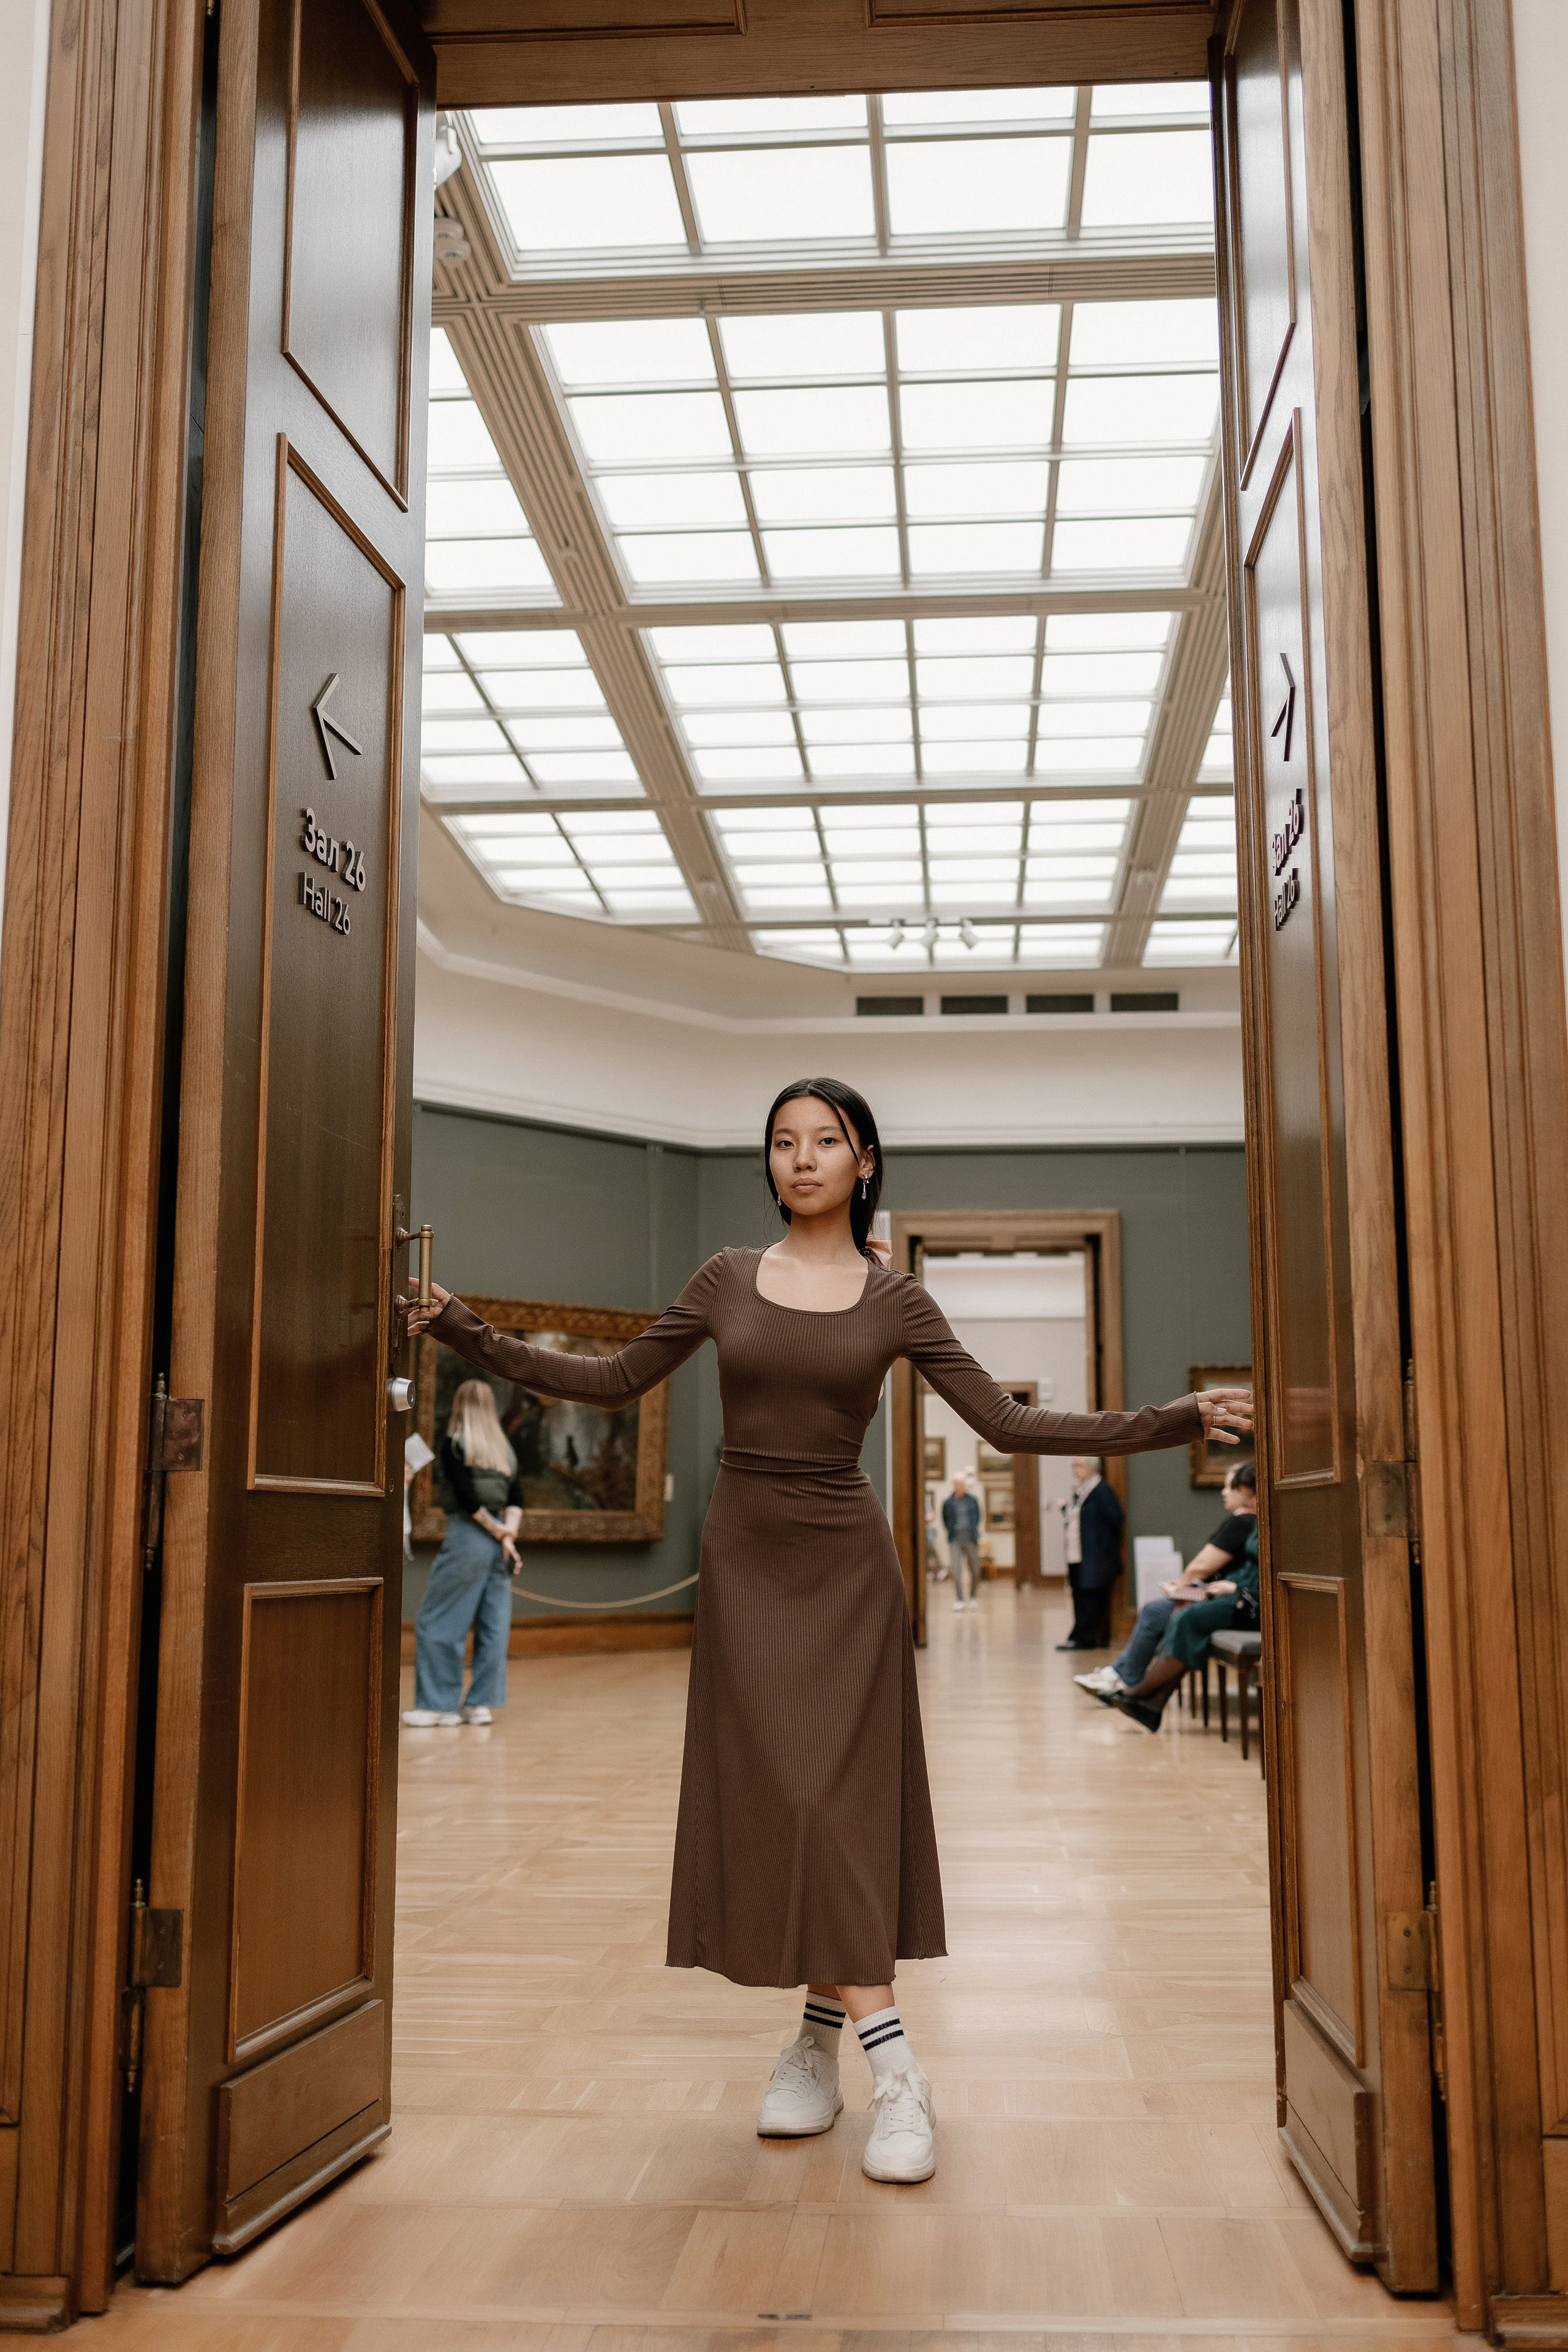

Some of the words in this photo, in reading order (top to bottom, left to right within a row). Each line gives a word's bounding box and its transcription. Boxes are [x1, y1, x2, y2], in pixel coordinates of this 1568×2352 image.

[1289, 788, 1303, 846] 26
[300, 807, 339, 873] Зал
[342, 840, 366, 892] 26
[299, 872, 331, 922] Hall
[332, 896, 351, 935] 26
[1274, 882, 1289, 931] Hall
[1287, 867, 1300, 909] 26
